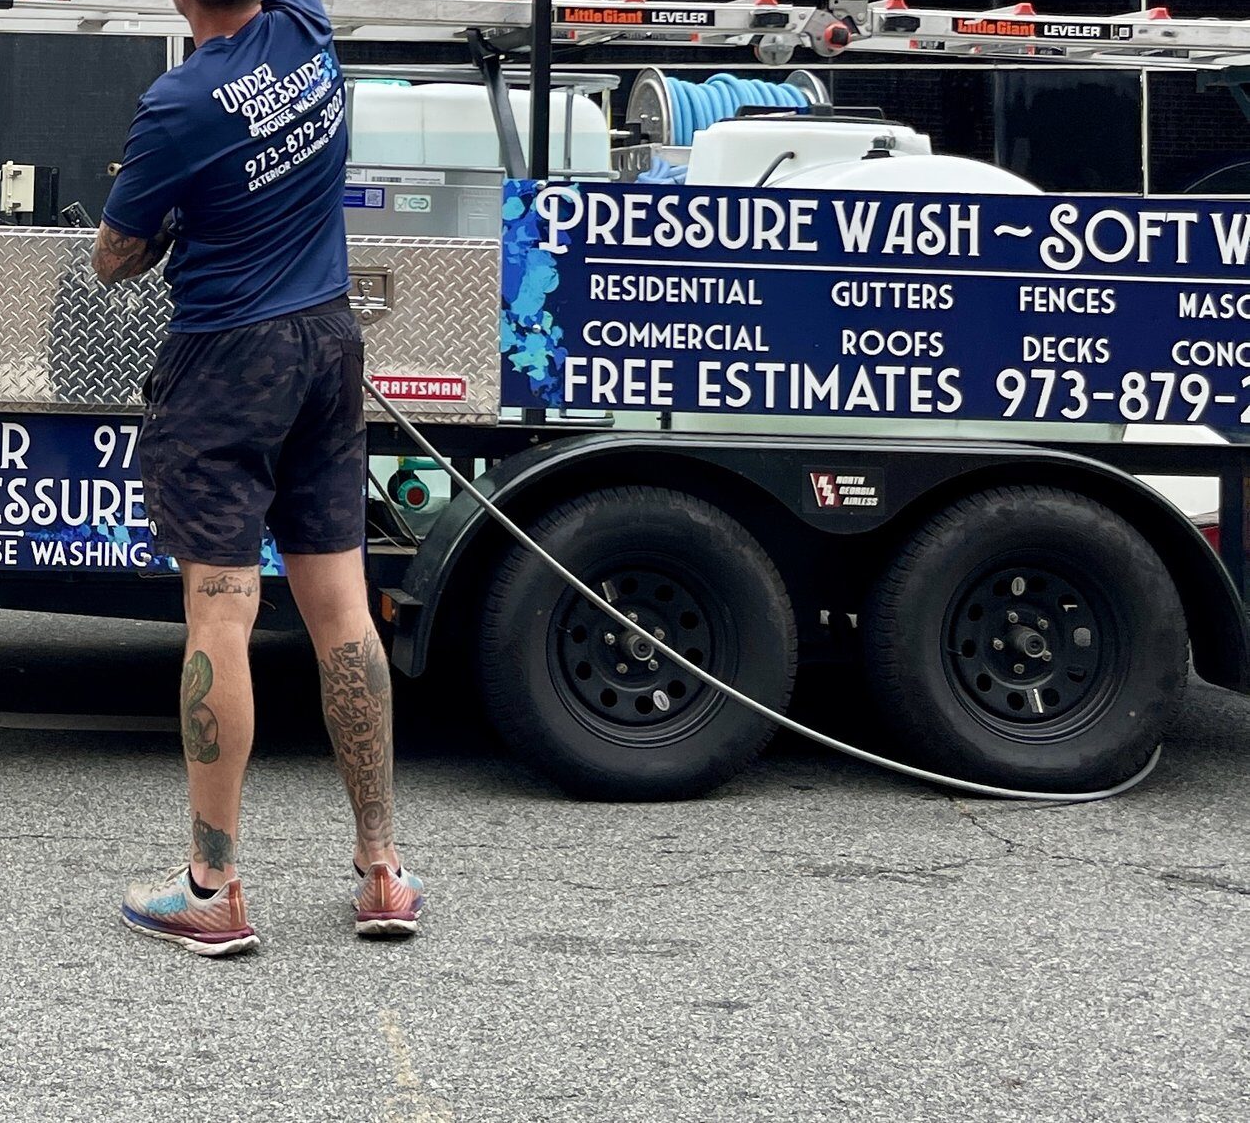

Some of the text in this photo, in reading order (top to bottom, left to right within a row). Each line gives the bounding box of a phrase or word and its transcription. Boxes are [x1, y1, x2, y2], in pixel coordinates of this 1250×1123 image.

[565, 8, 708, 24] Little Giant LEVELER
[1044, 24, 1100, 38] LEVELER
[212, 63, 277, 114] UNDER
[242, 54, 324, 124] PRESSURE
[259, 79, 332, 137] HOUSE WASHING
[245, 88, 343, 178] 973-879-2007
[248, 161, 291, 192] EXTERIOR
[292, 133, 329, 165] CLEANING
[536, 186, 818, 254] PRESSURE
[831, 200, 980, 257] WASH
[1040, 203, 1199, 271] SOFT
[590, 274, 763, 305] RESIDENTIAL
[831, 281, 954, 310] GUTTERS
[1019, 286, 1116, 314] FENCES
[582, 320, 770, 352] COMMERCIAL
[841, 329, 944, 357] ROOFS
[1023, 336, 1110, 363] DECKS
[563, 356, 674, 406] FREE
[698, 360, 963, 414] ESTIMATES
[836, 476, 865, 485] NORTH
[839, 486, 876, 495] GEORGIA
[843, 497, 879, 506] AIRLESS
[31, 541, 149, 567] WASHING
